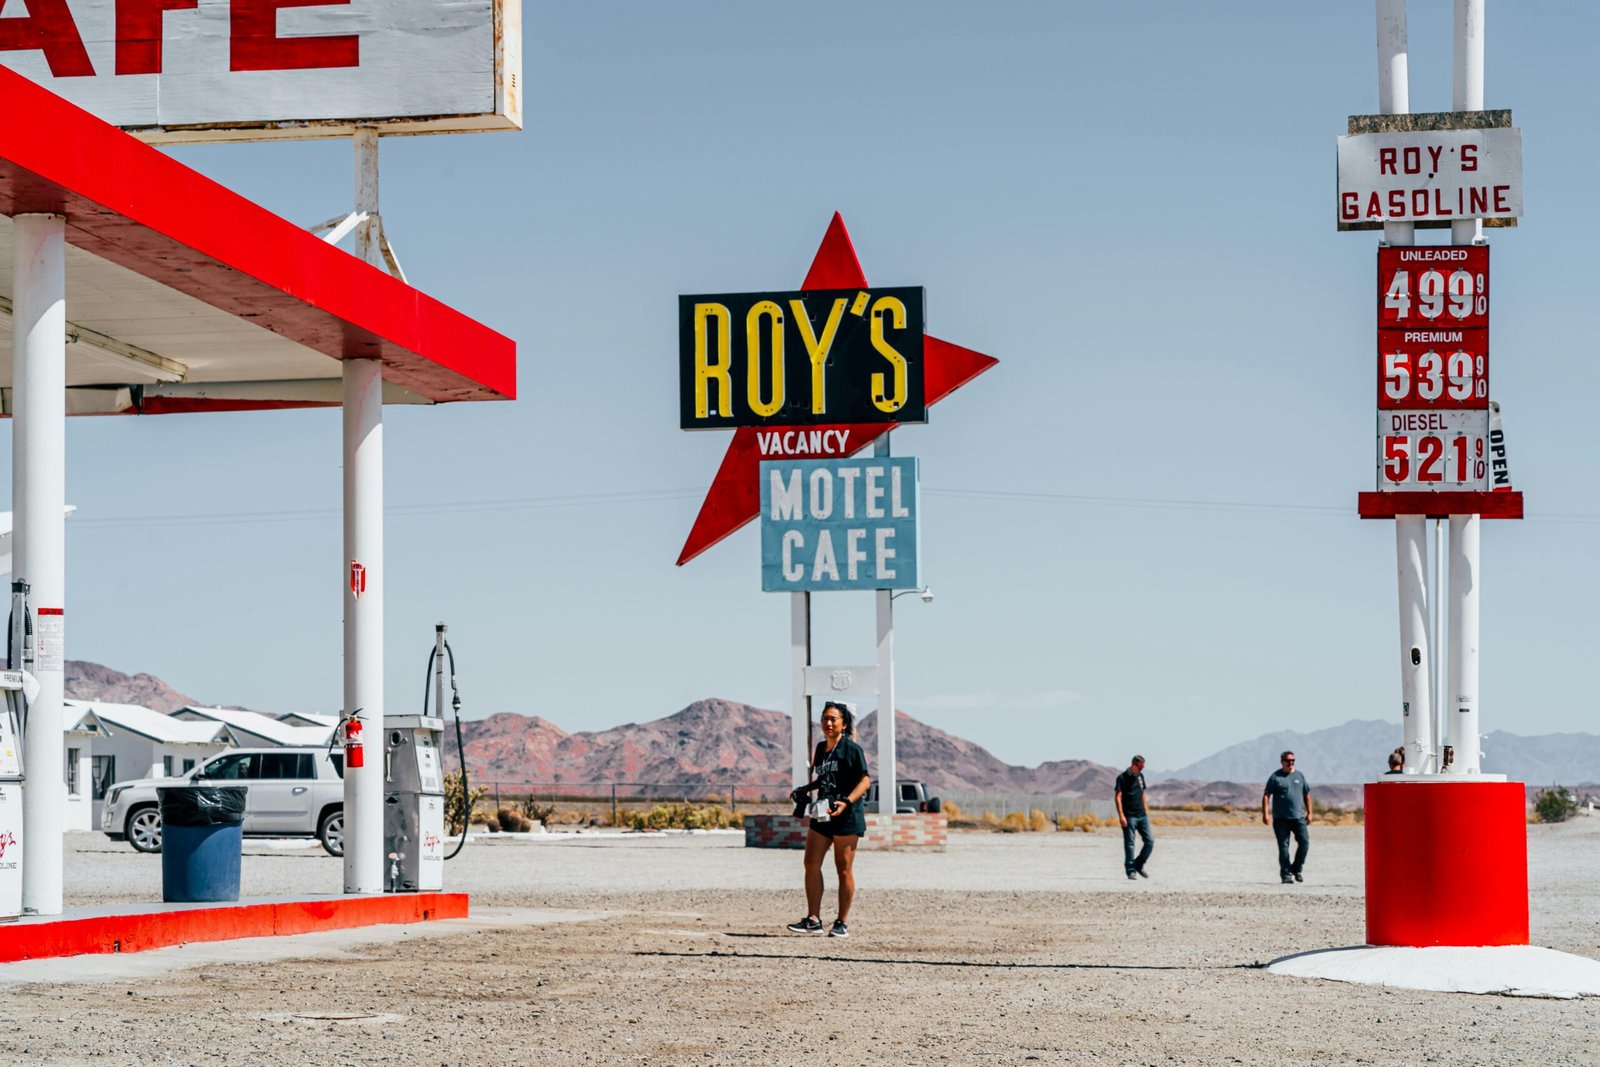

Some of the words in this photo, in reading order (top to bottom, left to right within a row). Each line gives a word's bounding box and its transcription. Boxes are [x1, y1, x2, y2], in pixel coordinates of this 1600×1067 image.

[1379, 144, 1478, 175] ROY'S
[1341, 185, 1512, 220] GASOLINE
[1400, 250, 1468, 261] UNLEADED
[1404, 332, 1463, 343] PREMIUM
[694, 291, 908, 418] ROY'S
[1392, 413, 1448, 431] DIESEL
[757, 429, 850, 455] VACANCY
[1490, 429, 1509, 485] OPEN
[770, 466, 909, 521] MOTEL
[782, 528, 896, 582] CAFE
